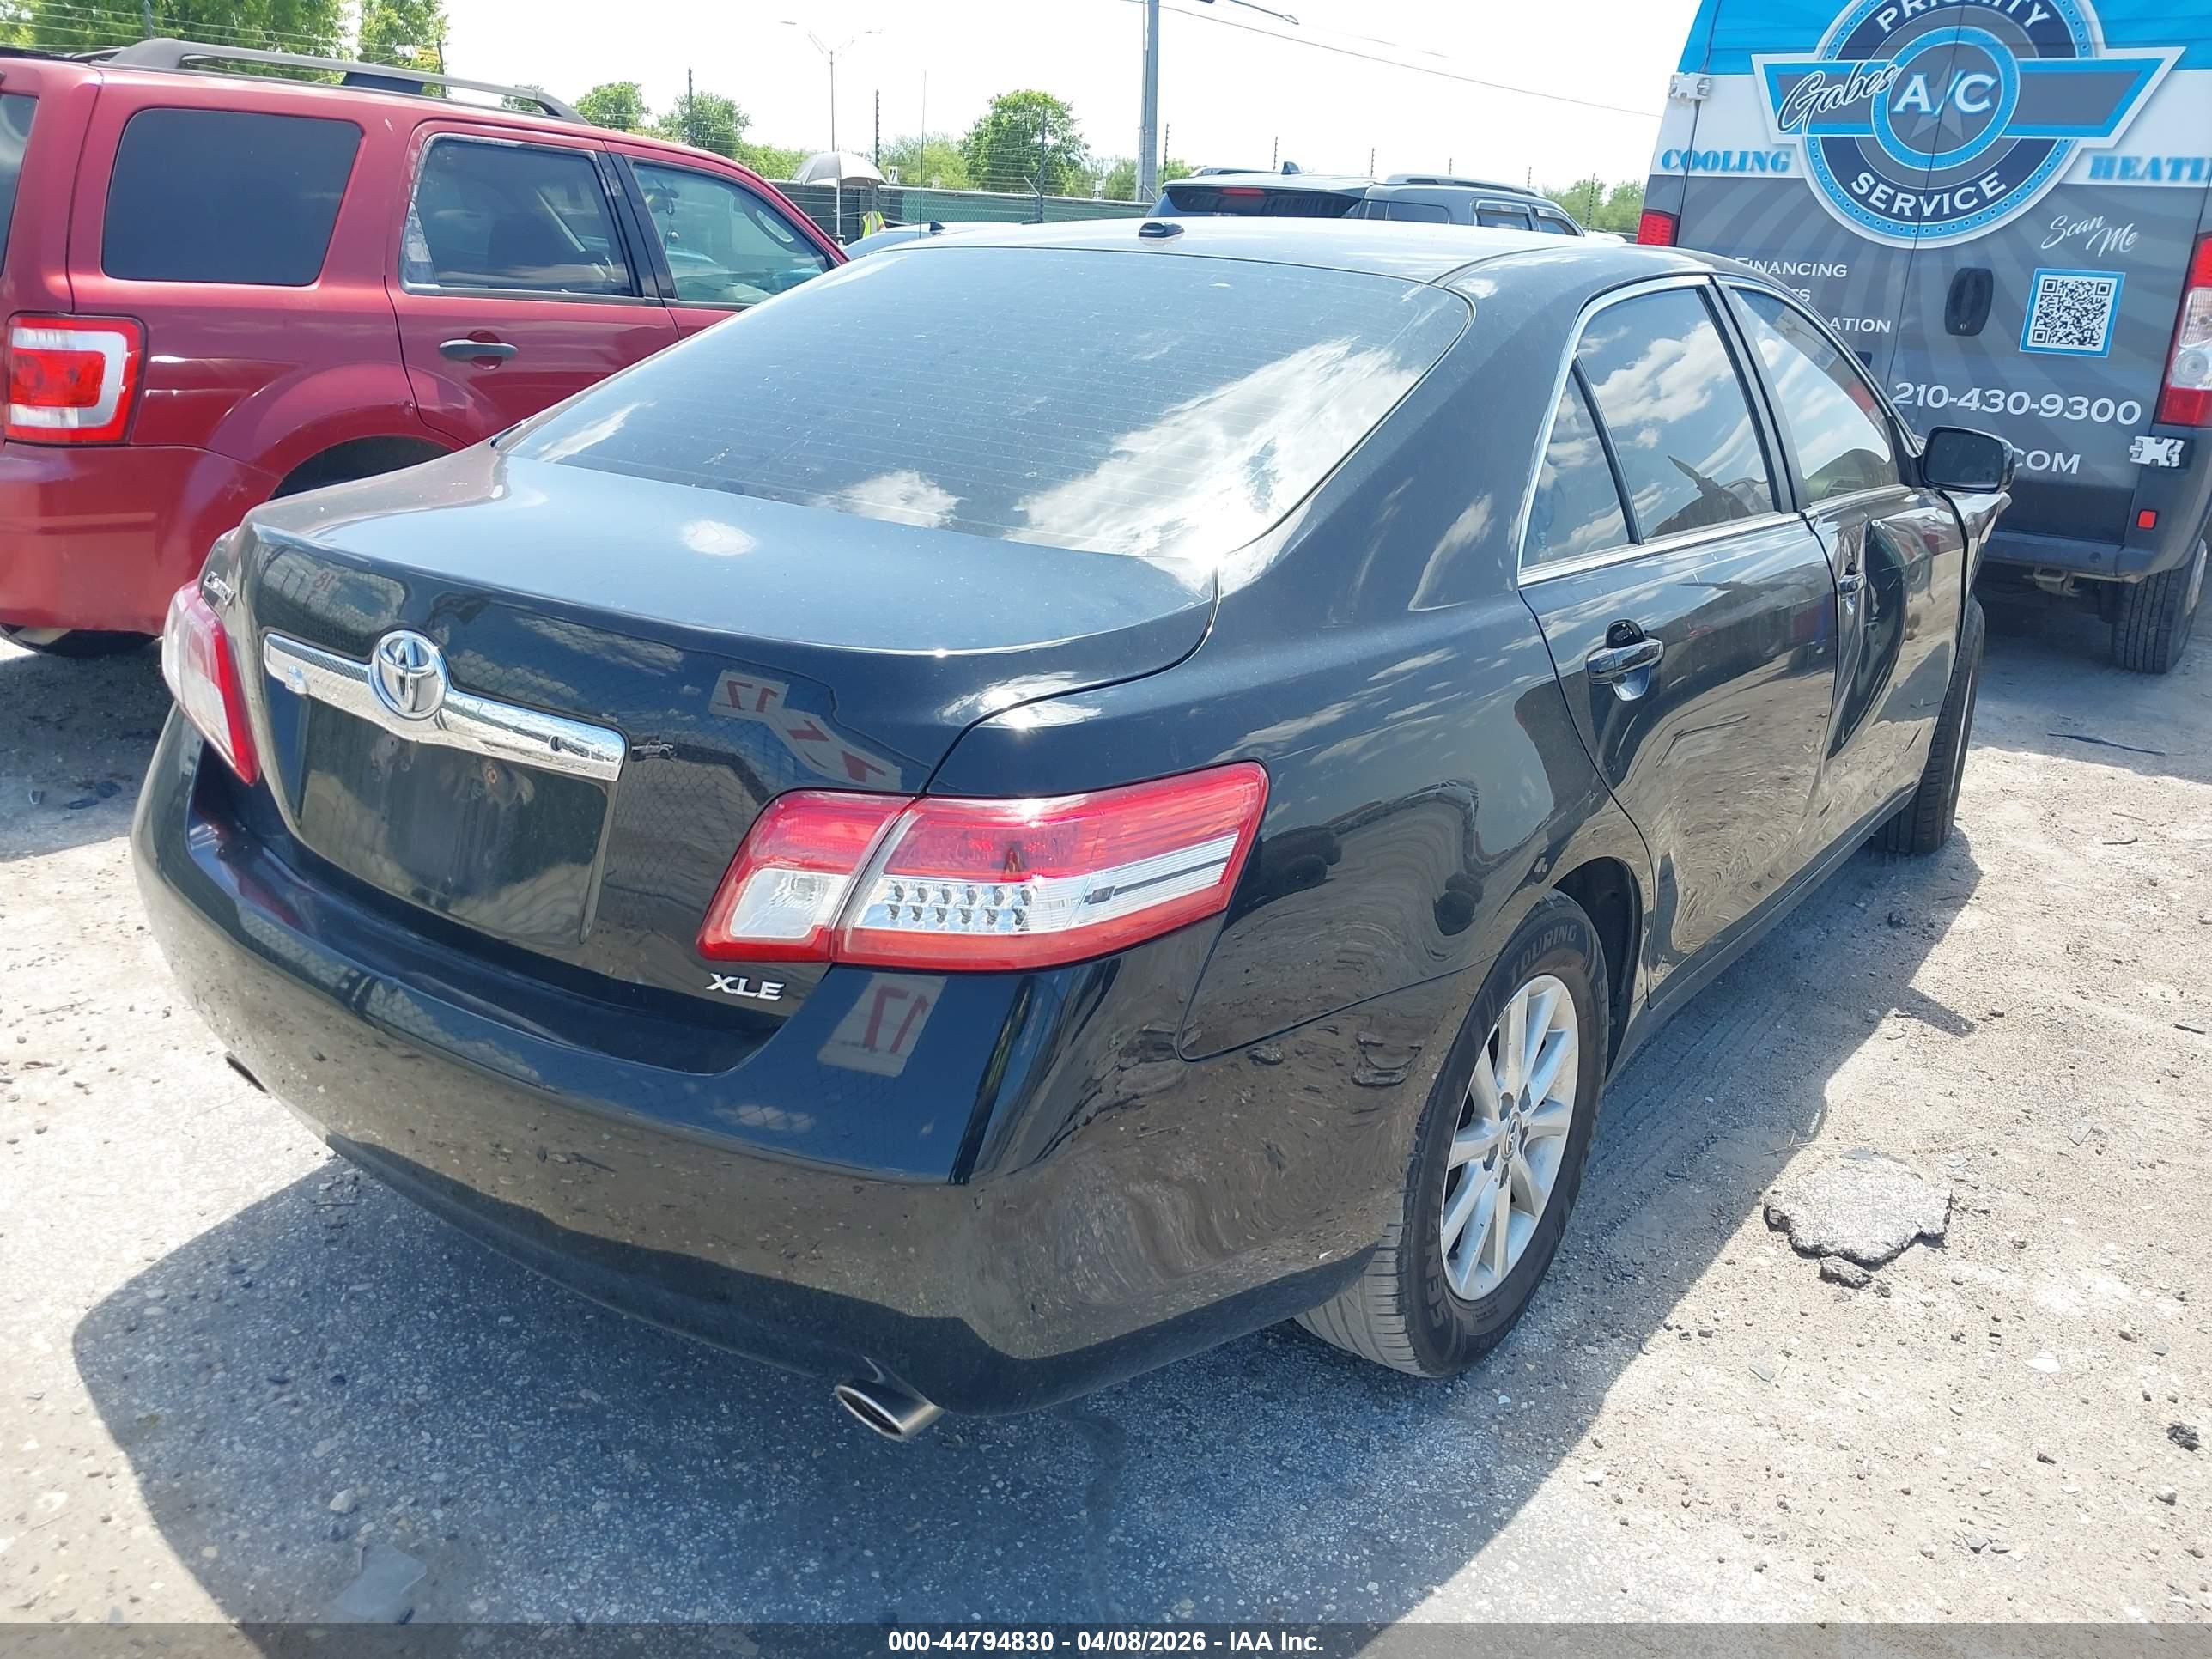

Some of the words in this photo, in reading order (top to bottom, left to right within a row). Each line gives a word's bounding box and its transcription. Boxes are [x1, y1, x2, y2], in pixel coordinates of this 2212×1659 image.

[1778, 62, 1903, 135] Gabes
[1891, 69, 1999, 117] A/C
[1662, 149, 1791, 172] COOLING
[2088, 156, 2212, 180] HEATI
[1850, 171, 2007, 216] SERVICE
[2041, 215, 2104, 249] Scan
[2086, 222, 2139, 257] Me
[1893, 382, 2142, 426] 210-430-9300
[1509, 924, 1577, 988] TOURING
[706, 972, 785, 1000] XLE
